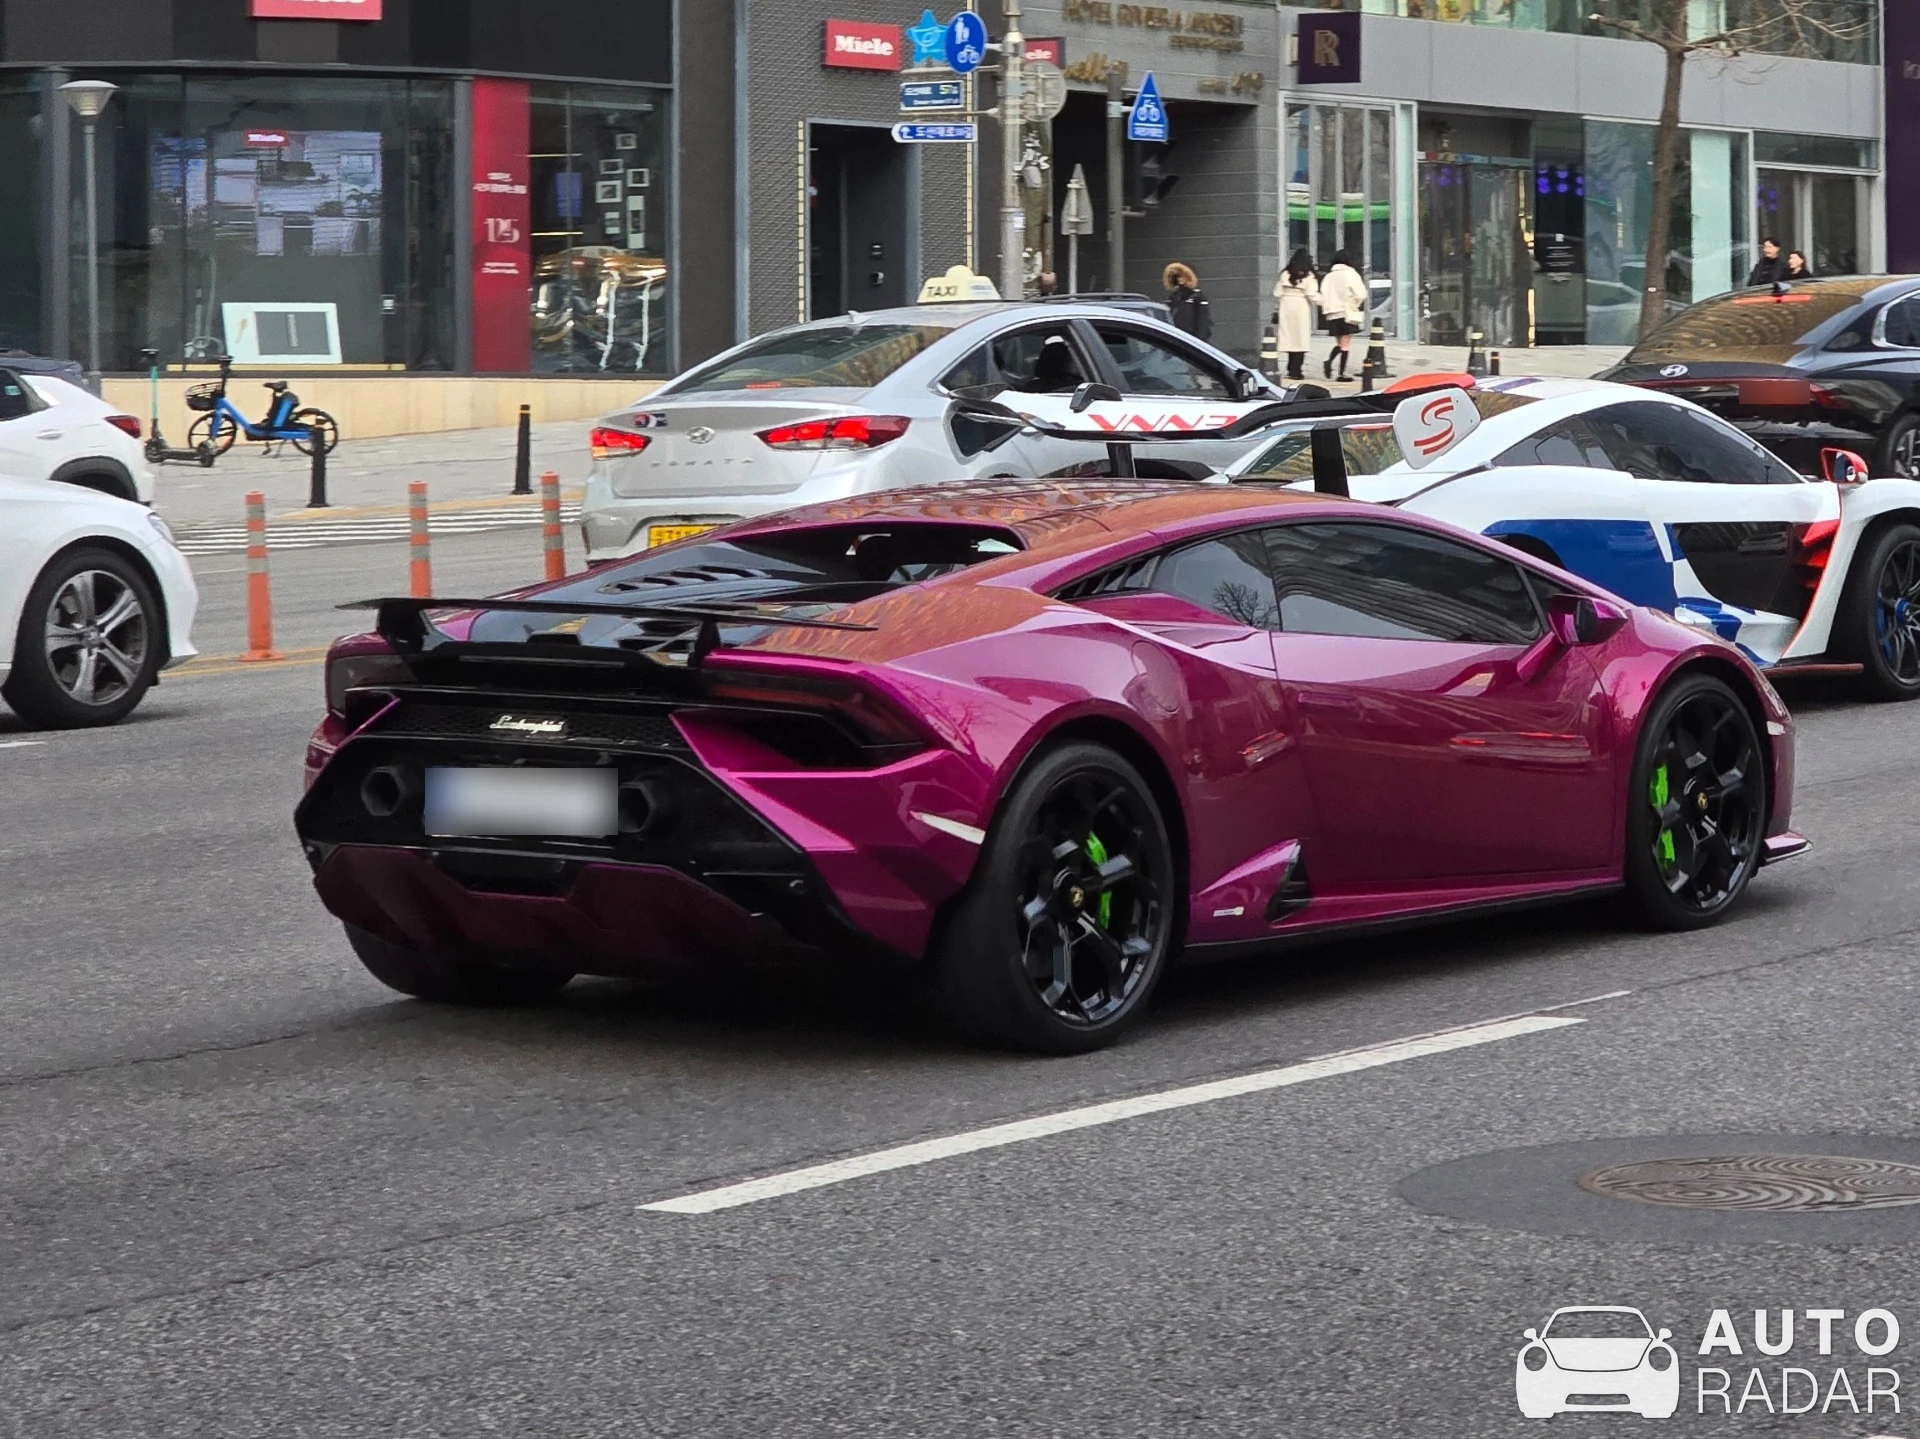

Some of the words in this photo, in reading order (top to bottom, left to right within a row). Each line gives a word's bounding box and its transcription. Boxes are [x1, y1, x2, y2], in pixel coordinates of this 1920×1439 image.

[834, 35, 894, 56] Miele
[1025, 48, 1053, 60] ele
[926, 285, 958, 298] TAXI
